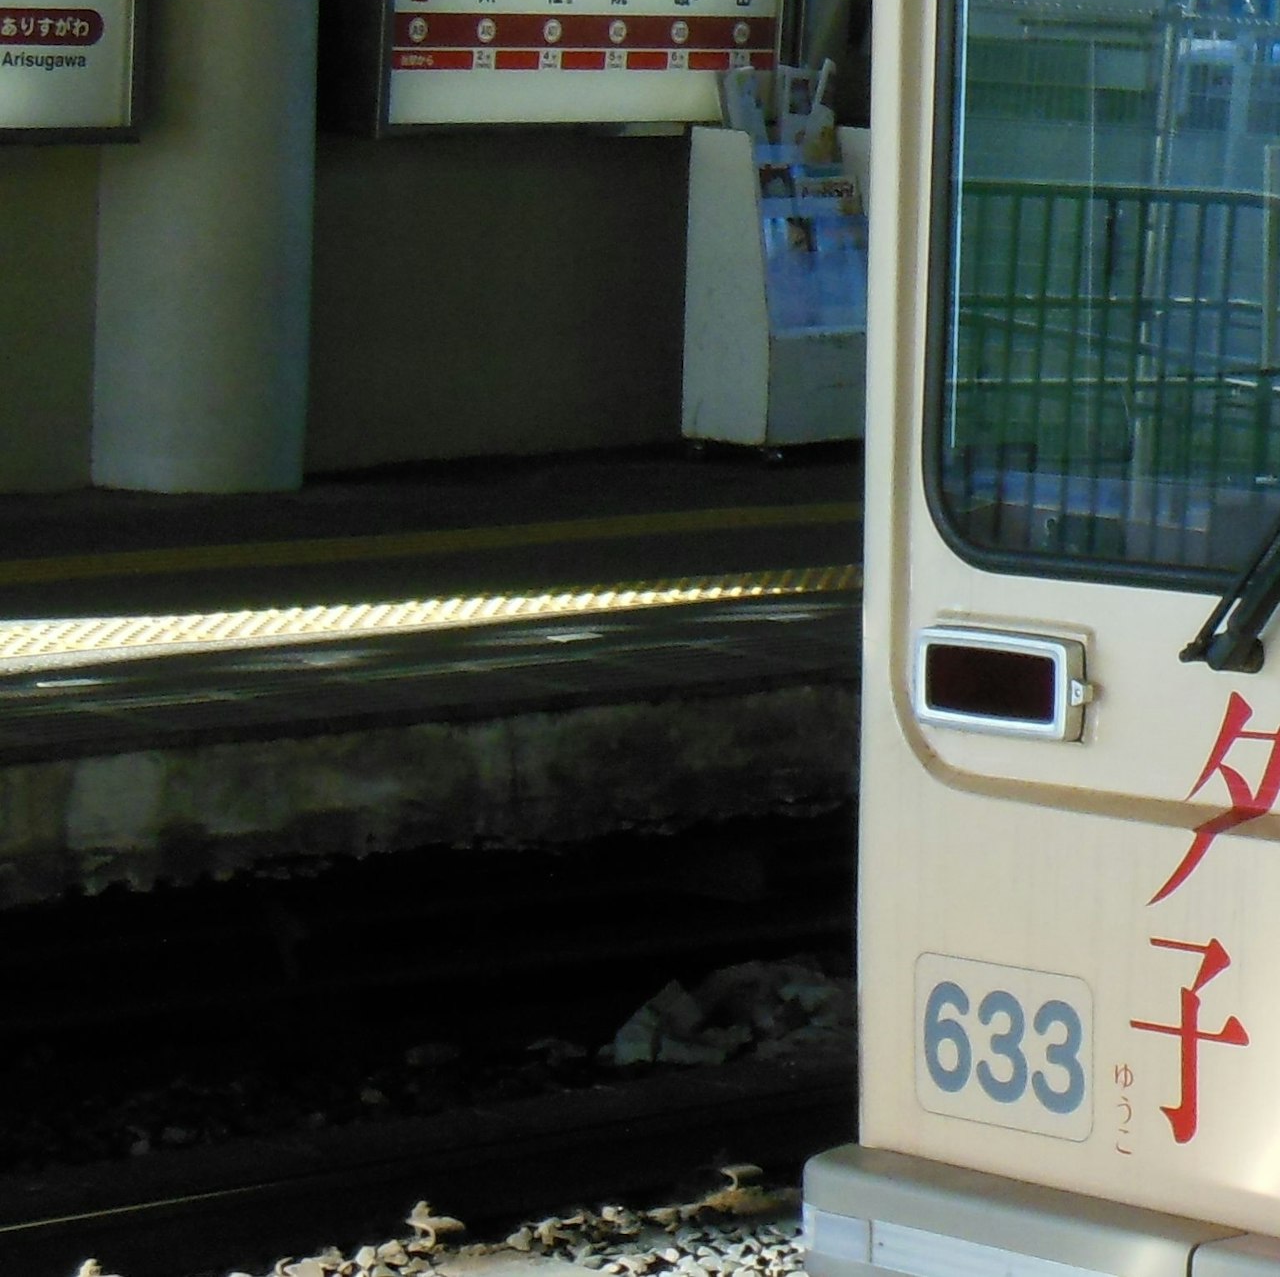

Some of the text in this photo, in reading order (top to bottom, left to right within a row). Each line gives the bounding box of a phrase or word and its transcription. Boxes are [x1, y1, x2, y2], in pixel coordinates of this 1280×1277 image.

[1, 16, 90, 38] ありすがわ
[1, 51, 87, 71] Arisugawa
[924, 980, 1086, 1114] 633
[1114, 1063, 1134, 1156] ゆうこ
